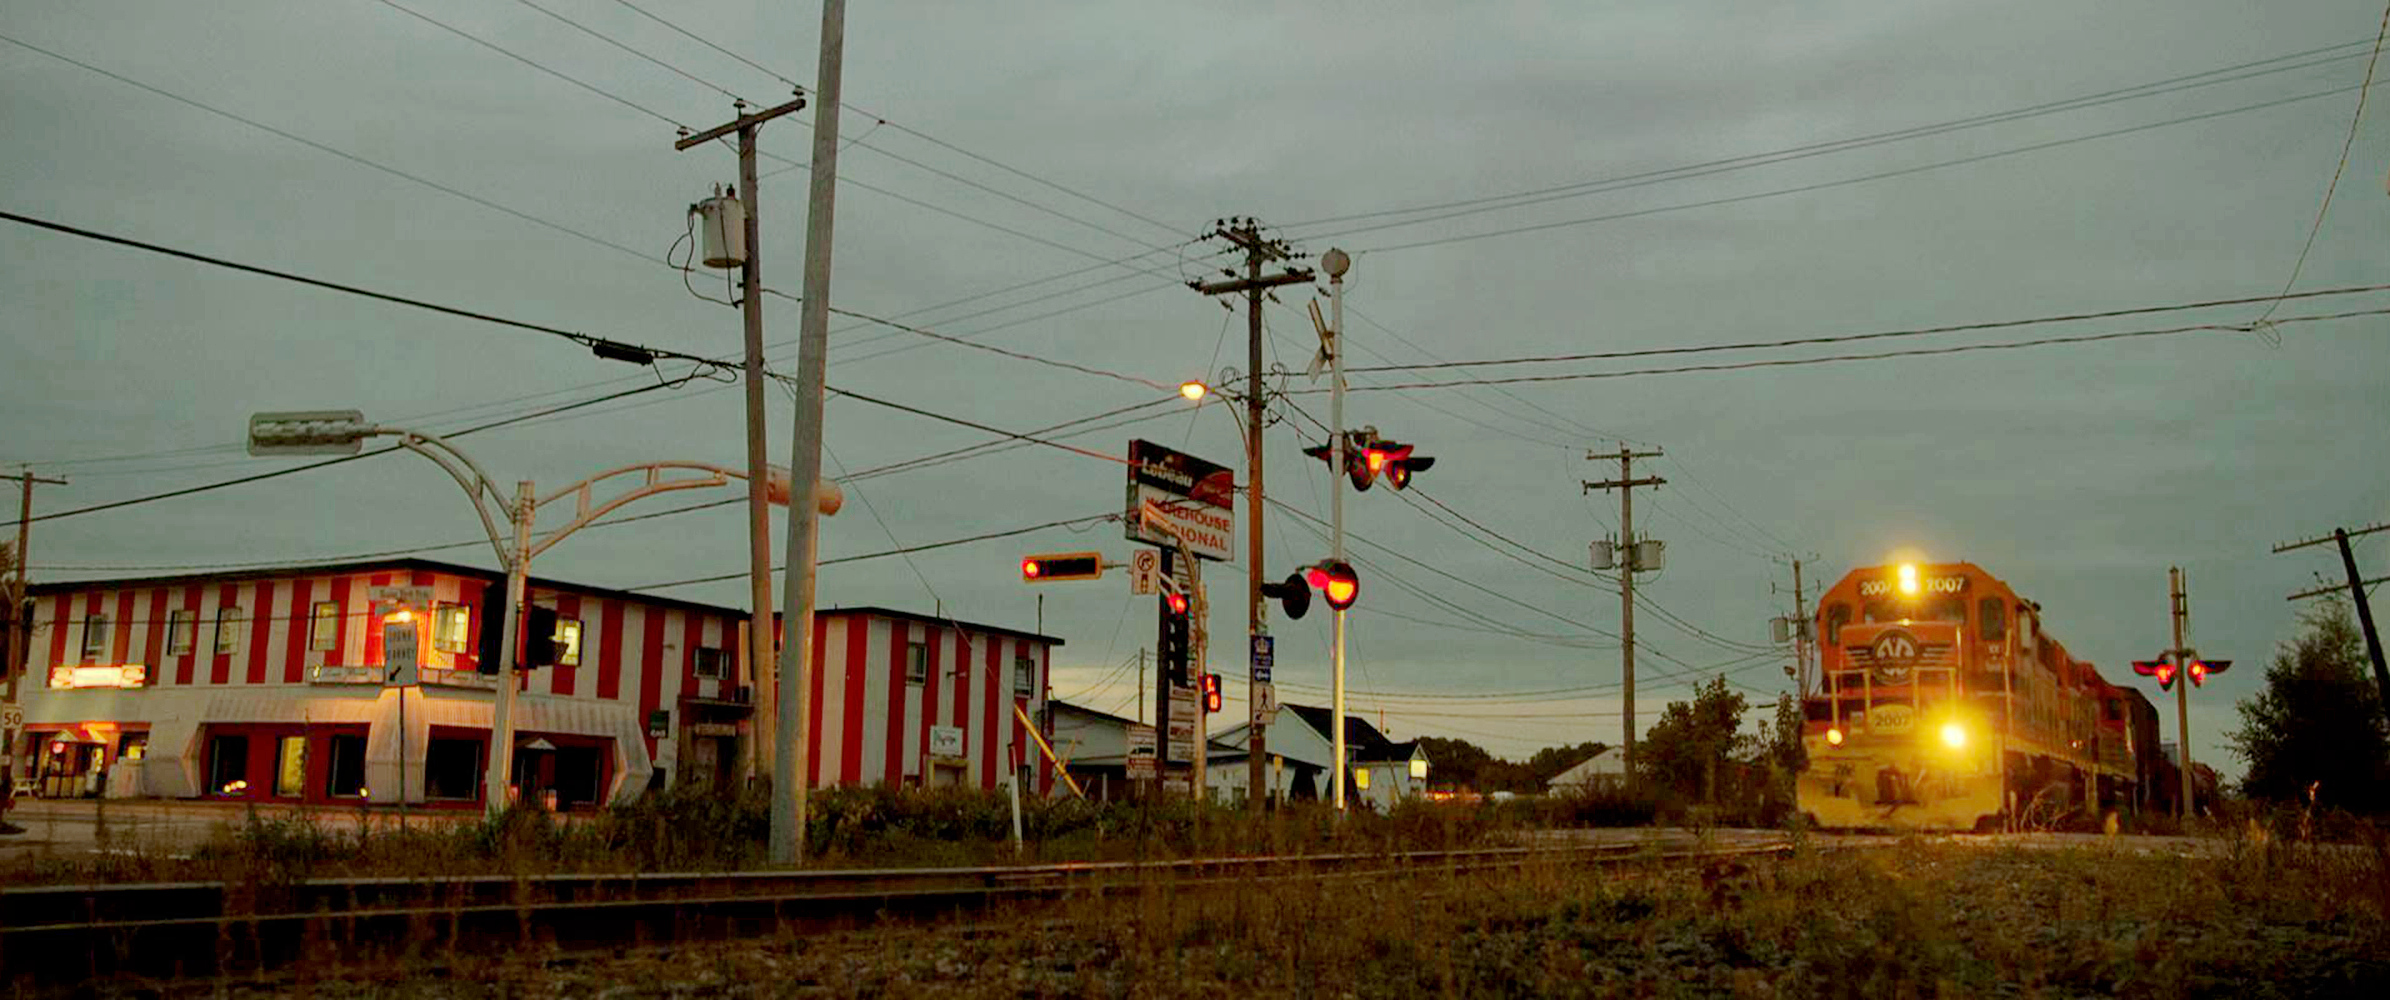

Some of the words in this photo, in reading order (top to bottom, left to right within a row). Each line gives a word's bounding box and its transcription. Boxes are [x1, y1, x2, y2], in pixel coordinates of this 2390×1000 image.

[1141, 456, 1194, 488] Lebeau
[1926, 576, 1965, 593] 2007
[4, 712, 22, 725] 50
[1874, 713, 1911, 727] 2007
